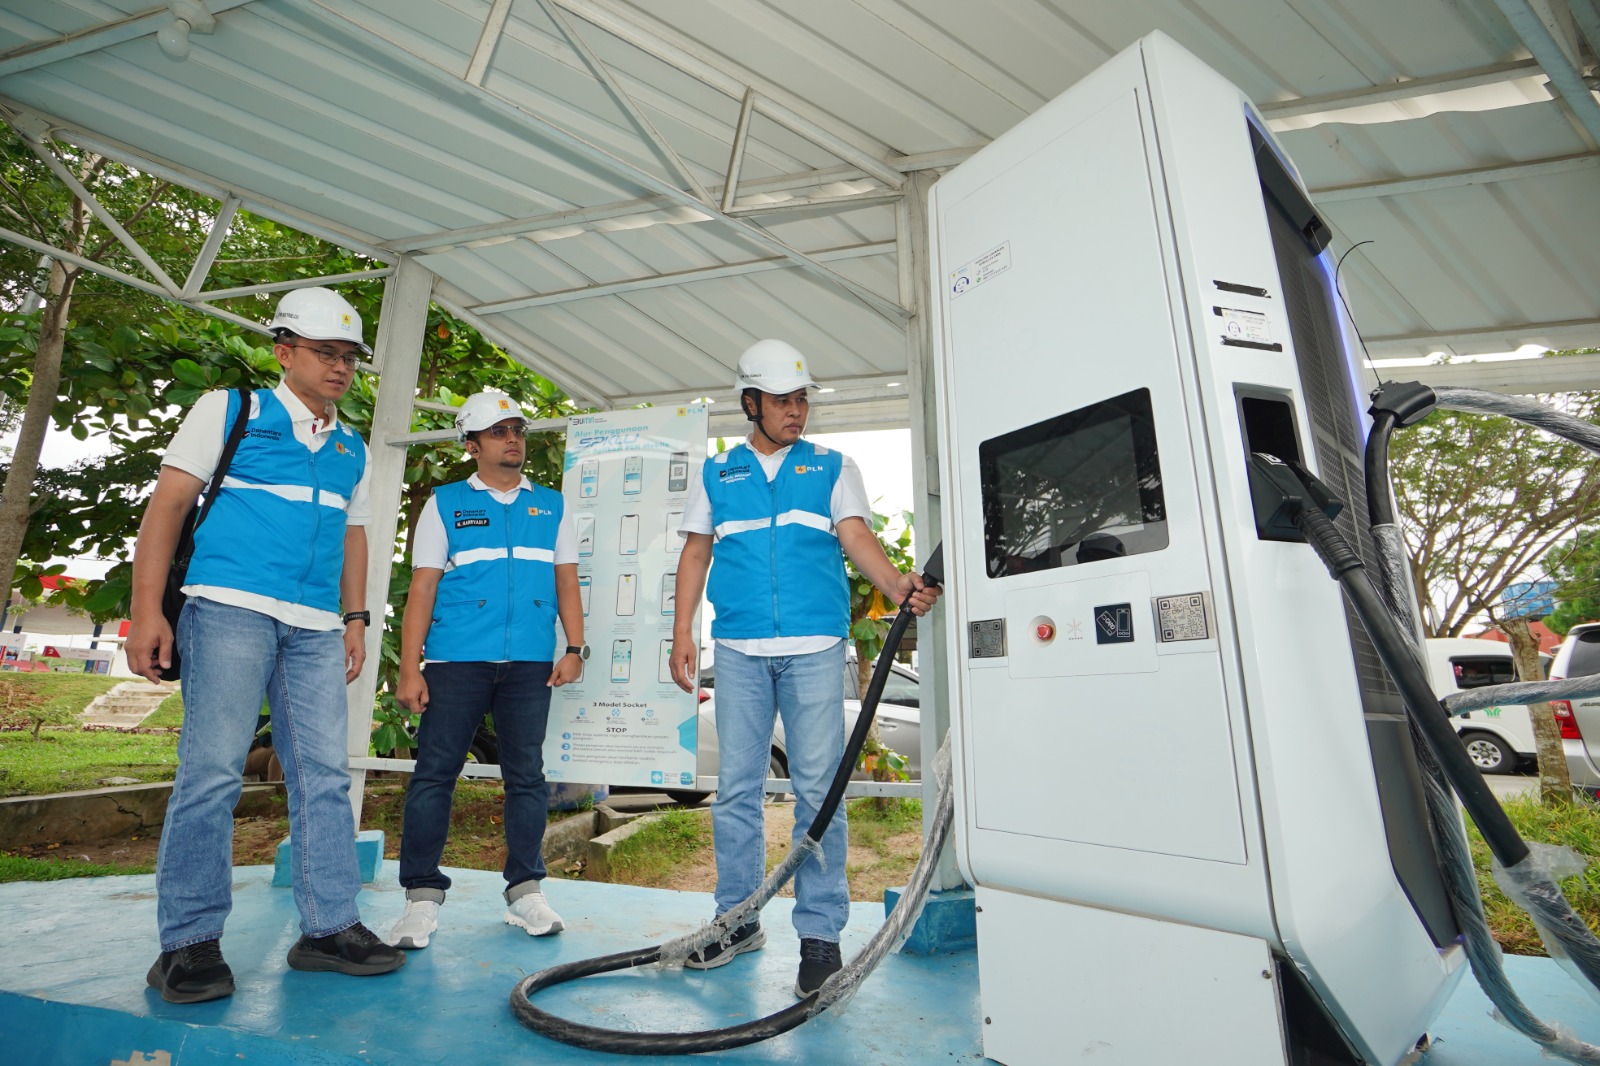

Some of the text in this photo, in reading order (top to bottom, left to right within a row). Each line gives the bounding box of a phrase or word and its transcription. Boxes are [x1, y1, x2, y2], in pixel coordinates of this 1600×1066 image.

[575, 425, 648, 438] Alur Penggunaan
[1101, 614, 1116, 630] CARD
